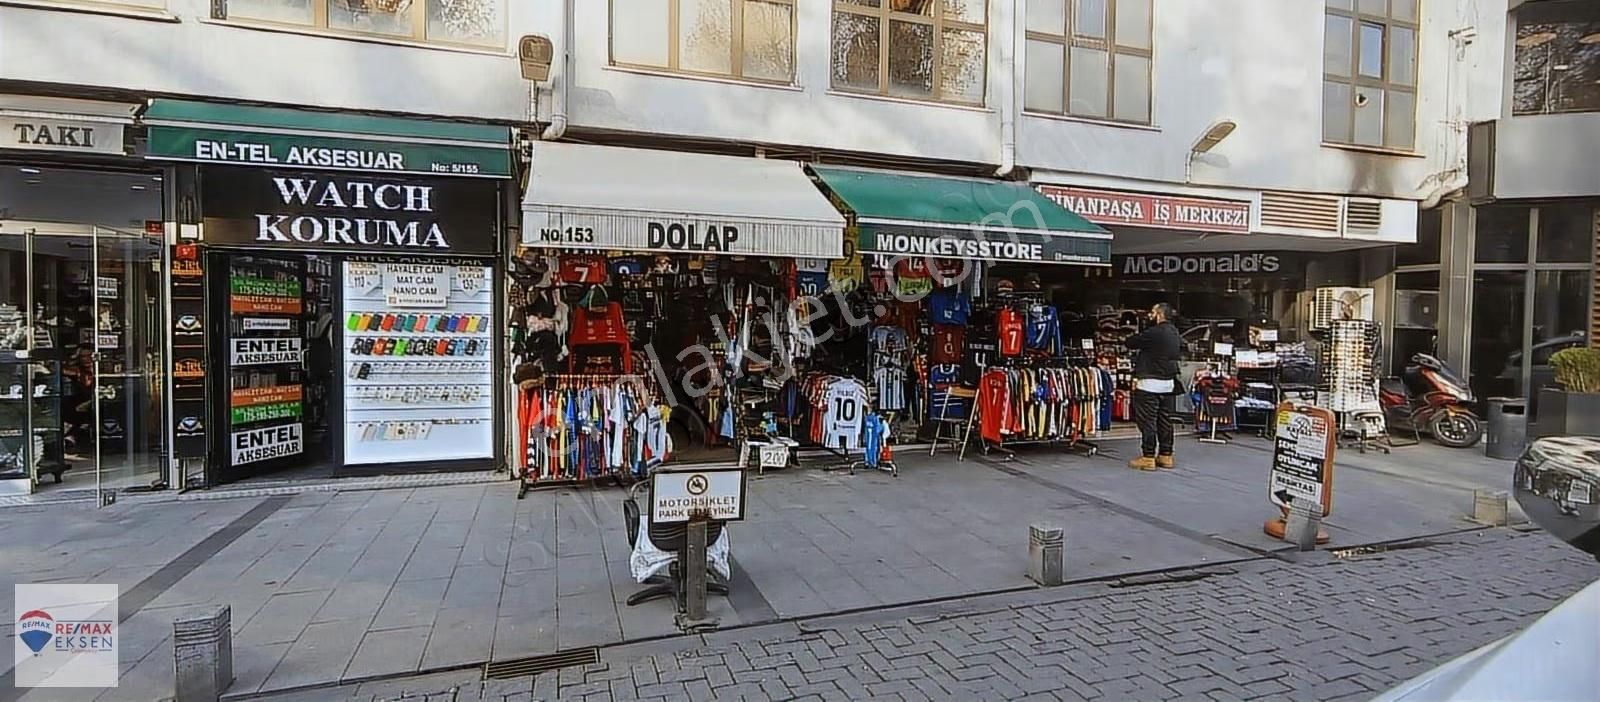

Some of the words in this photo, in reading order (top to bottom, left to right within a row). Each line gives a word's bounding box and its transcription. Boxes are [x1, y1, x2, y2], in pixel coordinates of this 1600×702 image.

[14, 123, 94, 147] TAKI
[196, 140, 278, 162] EN-TEL
[287, 147, 404, 170] AKSESUAR
[272, 177, 433, 212] WATCH
[1153, 199, 1170, 225] İŞ
[1175, 206, 1249, 227] MERKEZİ
[255, 214, 449, 248] KORUMA
[647, 221, 738, 252] DOLAP
[876, 234, 1042, 260] MONKEYSSTORE
[387, 264, 422, 273] HAYALET
[425, 265, 443, 274] CAM
[1123, 253, 1280, 273] McDonald's
[393, 287, 417, 295] NANO
[419, 288, 437, 296] CAM
[416, 277, 434, 285] CAM
[236, 340, 298, 353] ENTEL
[236, 352, 298, 363] AKSESUAR
[835, 397, 856, 421] 10
[236, 425, 298, 449] ENTEL
[238, 442, 299, 463] AKSESUAR
[658, 509, 684, 518] PARK
